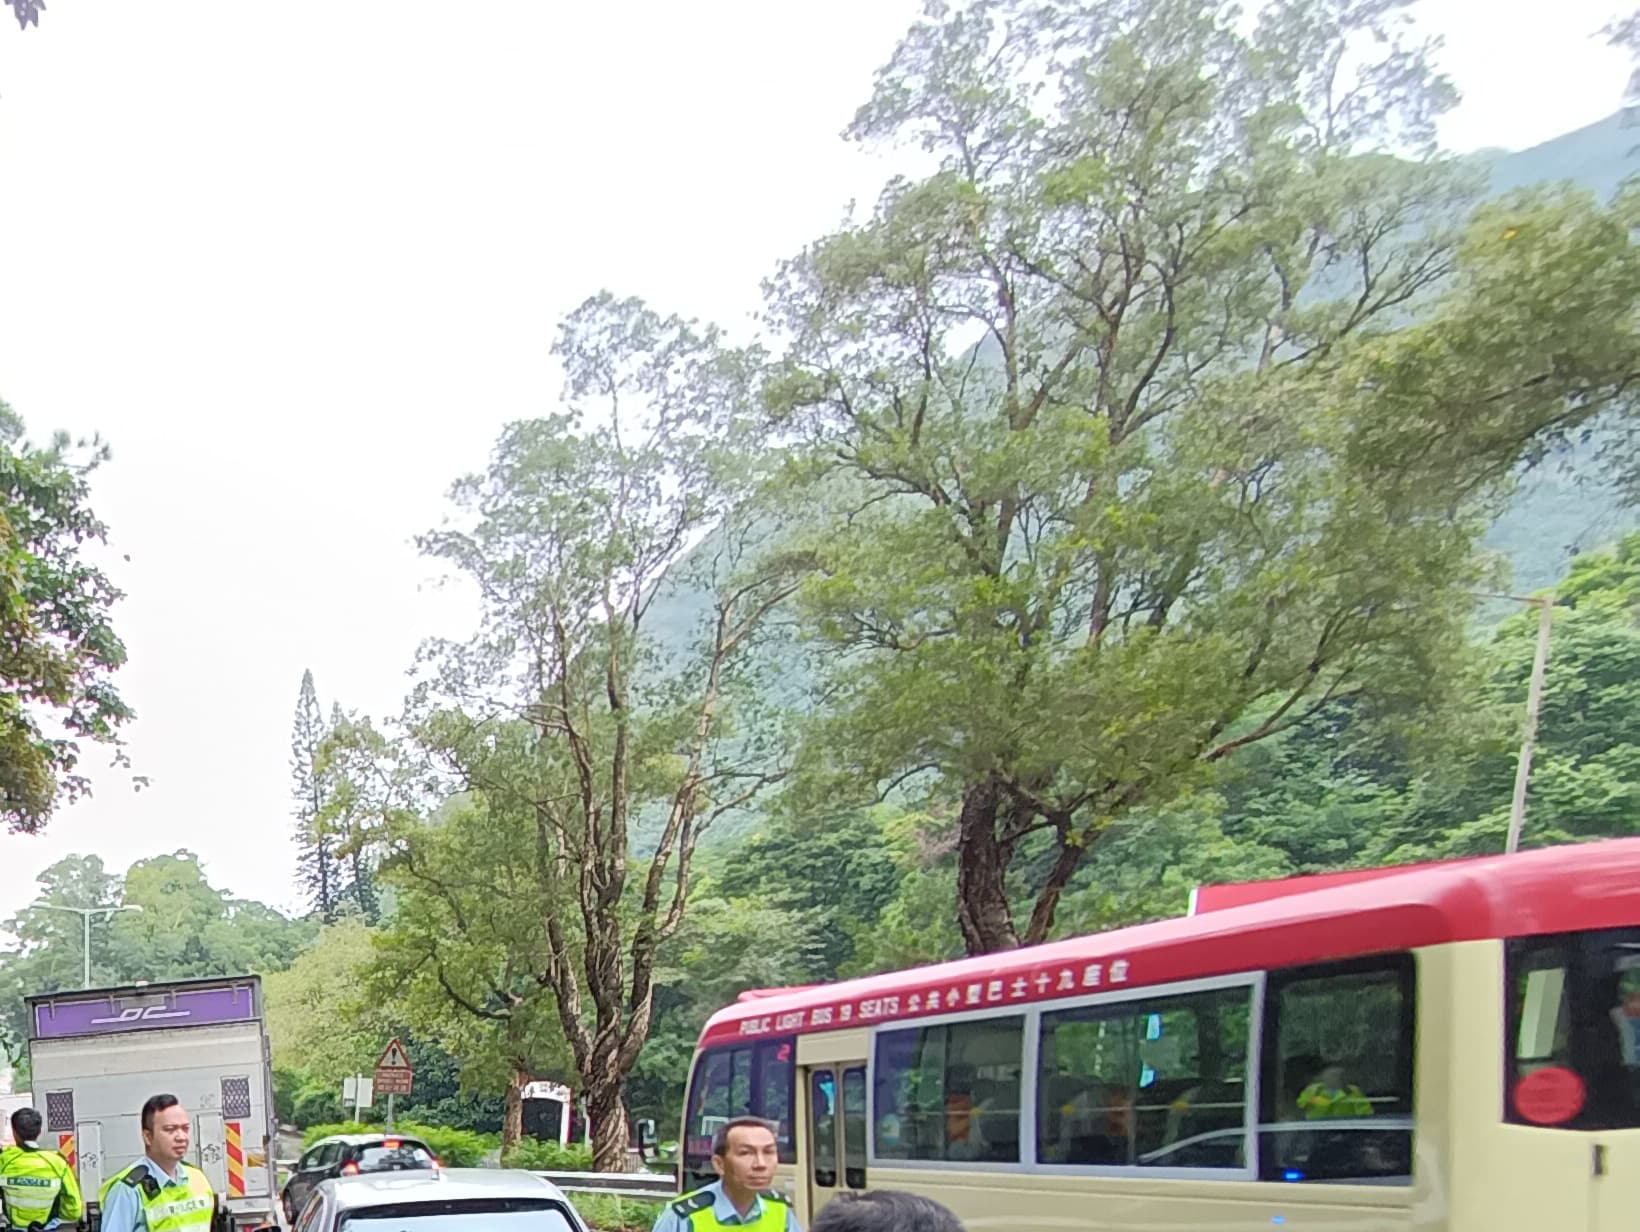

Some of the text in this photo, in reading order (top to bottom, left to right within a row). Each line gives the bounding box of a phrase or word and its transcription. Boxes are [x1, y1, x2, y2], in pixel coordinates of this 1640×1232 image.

[739, 1017, 771, 1036] PUBLIC
[775, 1011, 805, 1031] LIGHT
[811, 1006, 833, 1026] BUS
[859, 996, 900, 1018] SEATS
